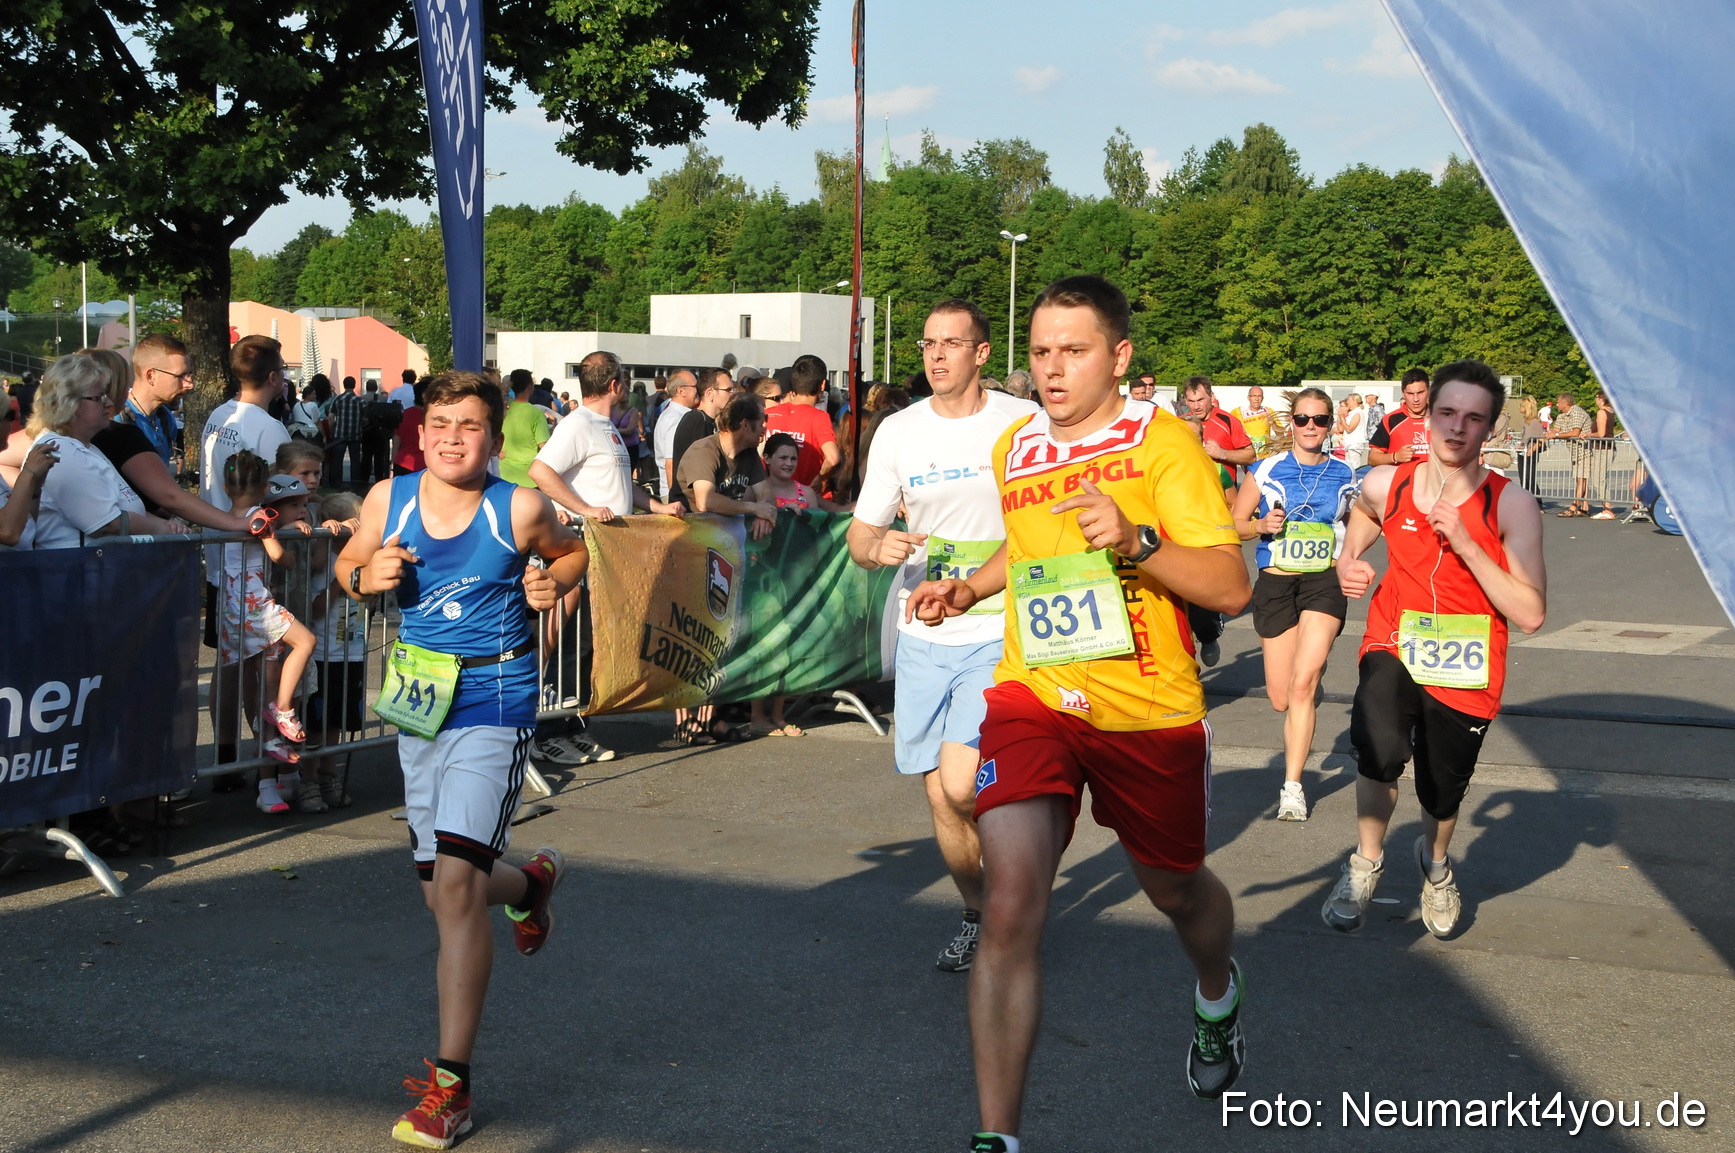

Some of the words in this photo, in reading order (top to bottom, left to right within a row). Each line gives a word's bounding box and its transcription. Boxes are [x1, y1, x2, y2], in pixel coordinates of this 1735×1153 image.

[1002, 480, 1056, 514] MAX
[1064, 458, 1144, 494] BÖGL
[1278, 539, 1330, 559] 1038
[416, 595, 435, 612] Team
[433, 581, 461, 597] Schick
[461, 575, 481, 585] Bau
[1028, 589, 1103, 640] 831
[1402, 640, 1484, 670] 1326
[392, 670, 436, 717] 741
